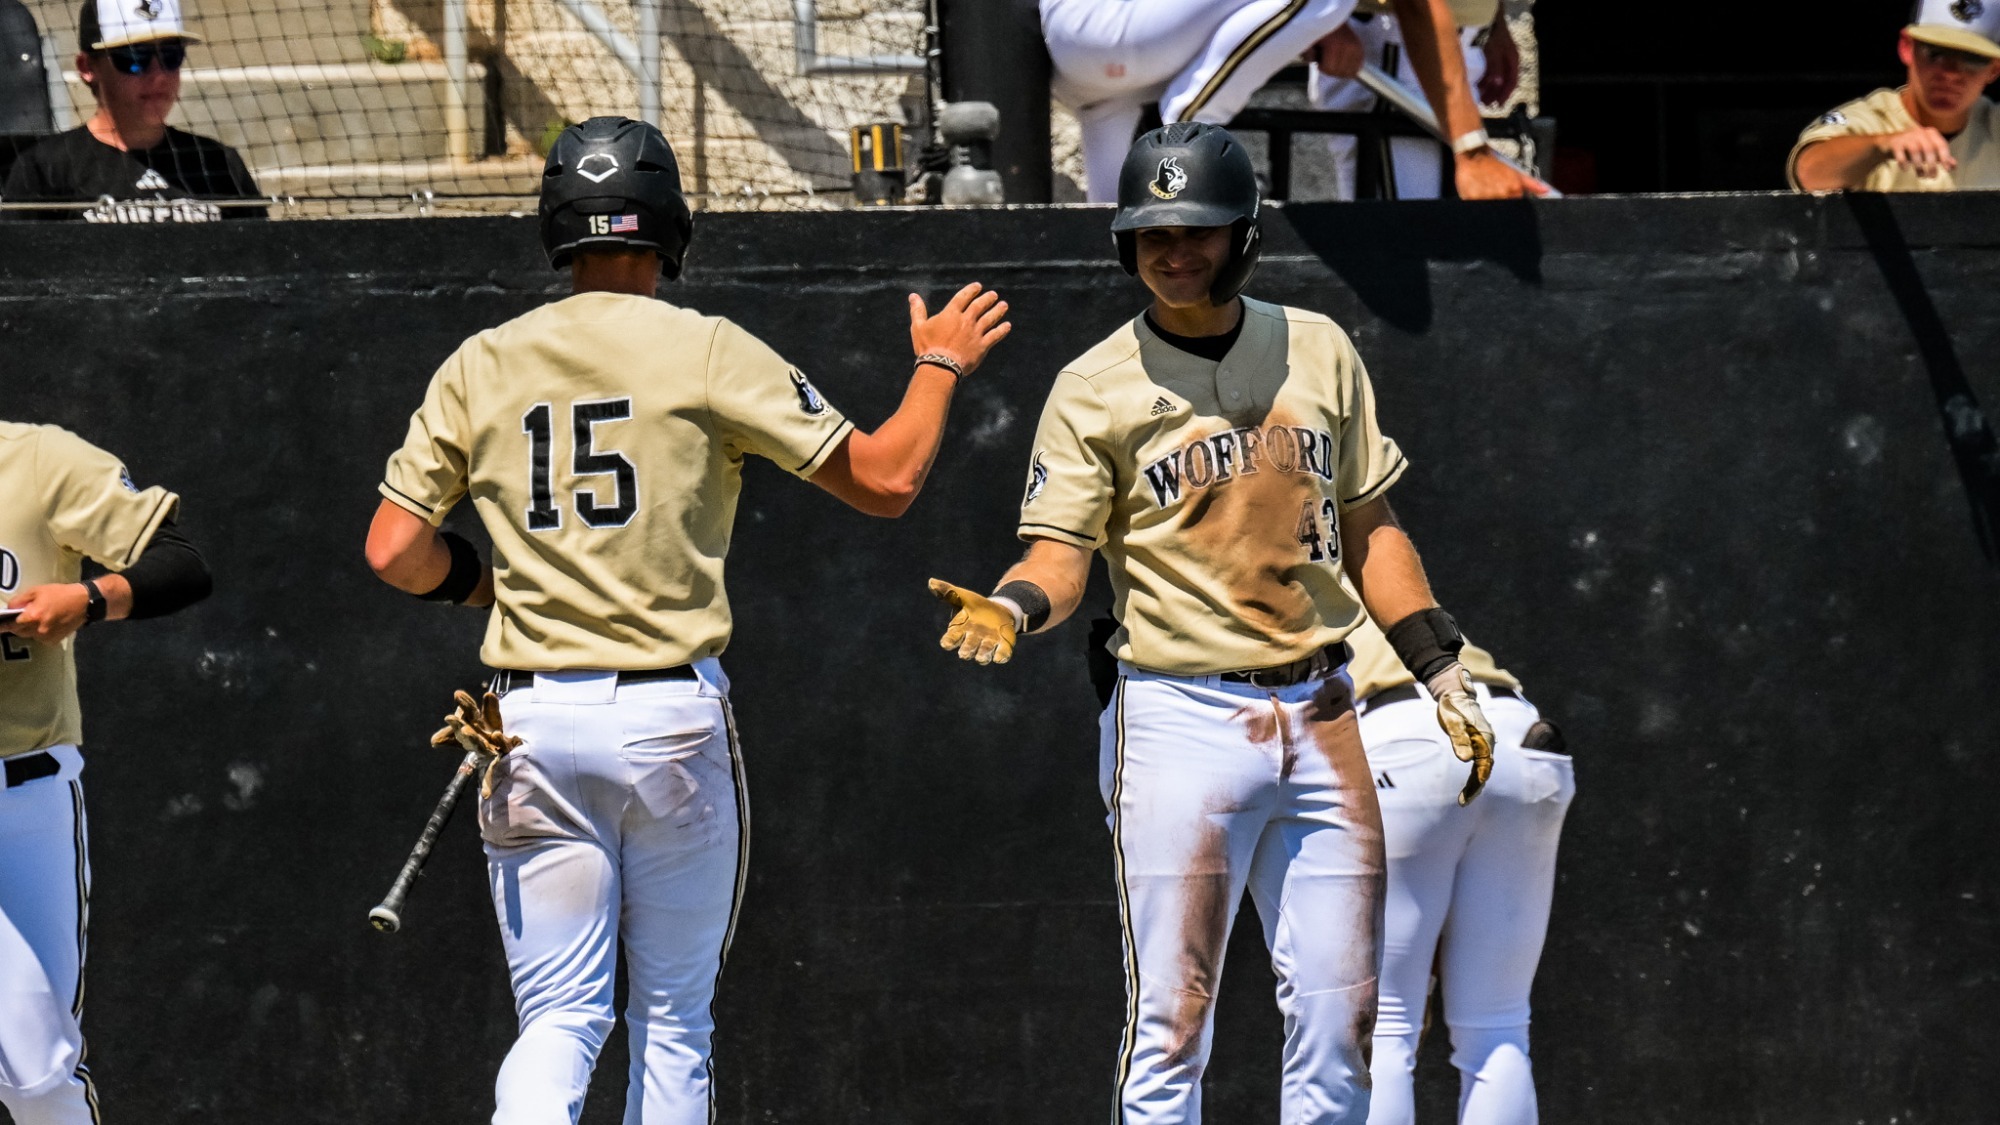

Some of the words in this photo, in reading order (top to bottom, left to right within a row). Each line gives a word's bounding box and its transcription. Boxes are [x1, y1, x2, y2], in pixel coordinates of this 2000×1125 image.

[588, 214, 610, 235] 15
[521, 395, 641, 533] 15
[1142, 425, 1334, 510] WOFFORD
[1294, 497, 1342, 565] 43
